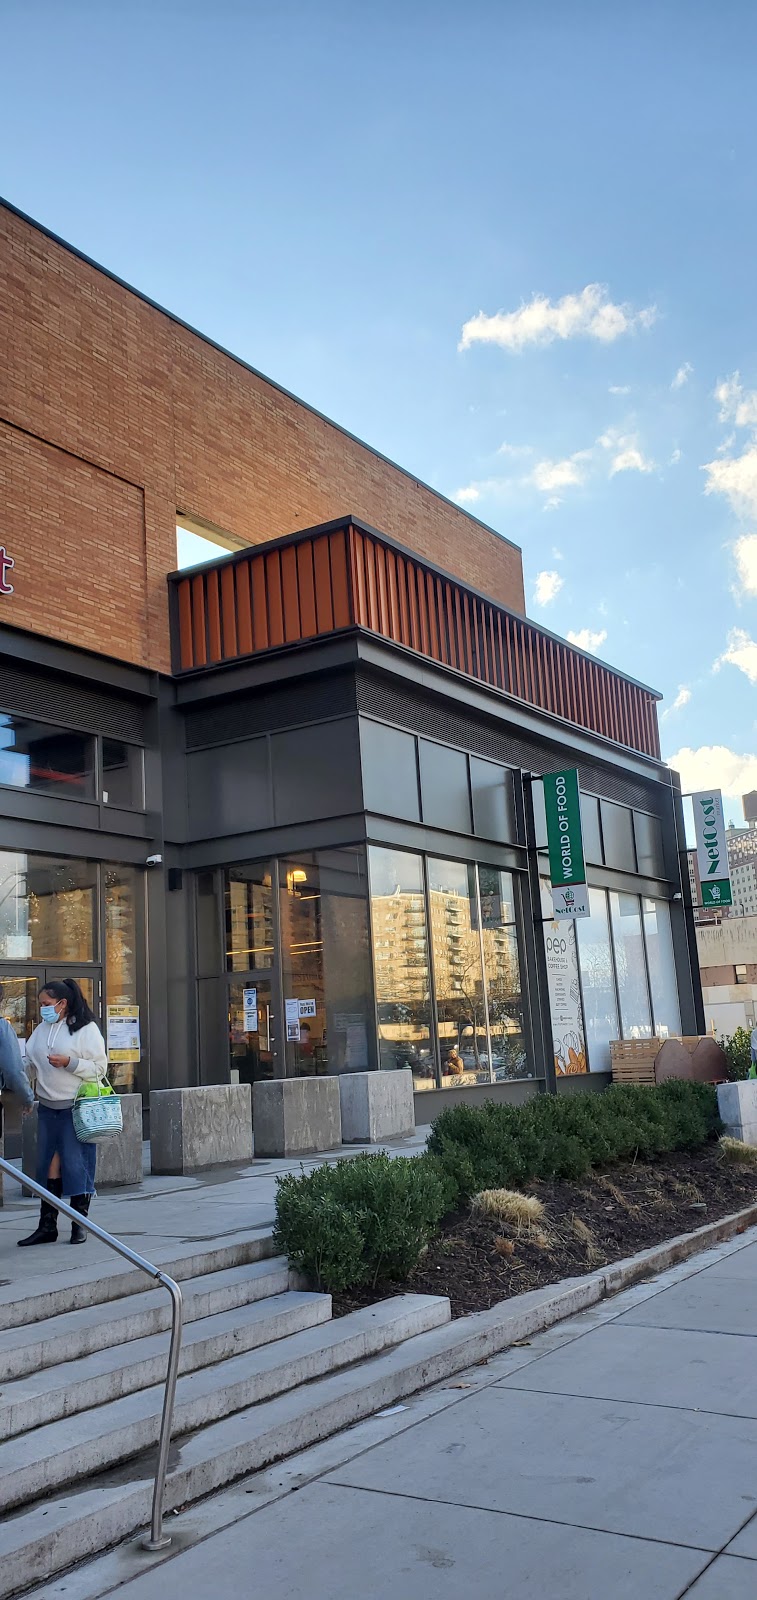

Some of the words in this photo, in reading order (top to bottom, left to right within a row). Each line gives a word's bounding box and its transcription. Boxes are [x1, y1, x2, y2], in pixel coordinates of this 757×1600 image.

[555, 776, 567, 812] FOOD
[558, 814, 569, 832] OF
[699, 796, 721, 875] NetCost
[560, 834, 573, 879] WORLD
[555, 905, 586, 915] NetCost
[546, 937, 566, 954] pep
[300, 1006, 314, 1014] OPEN
